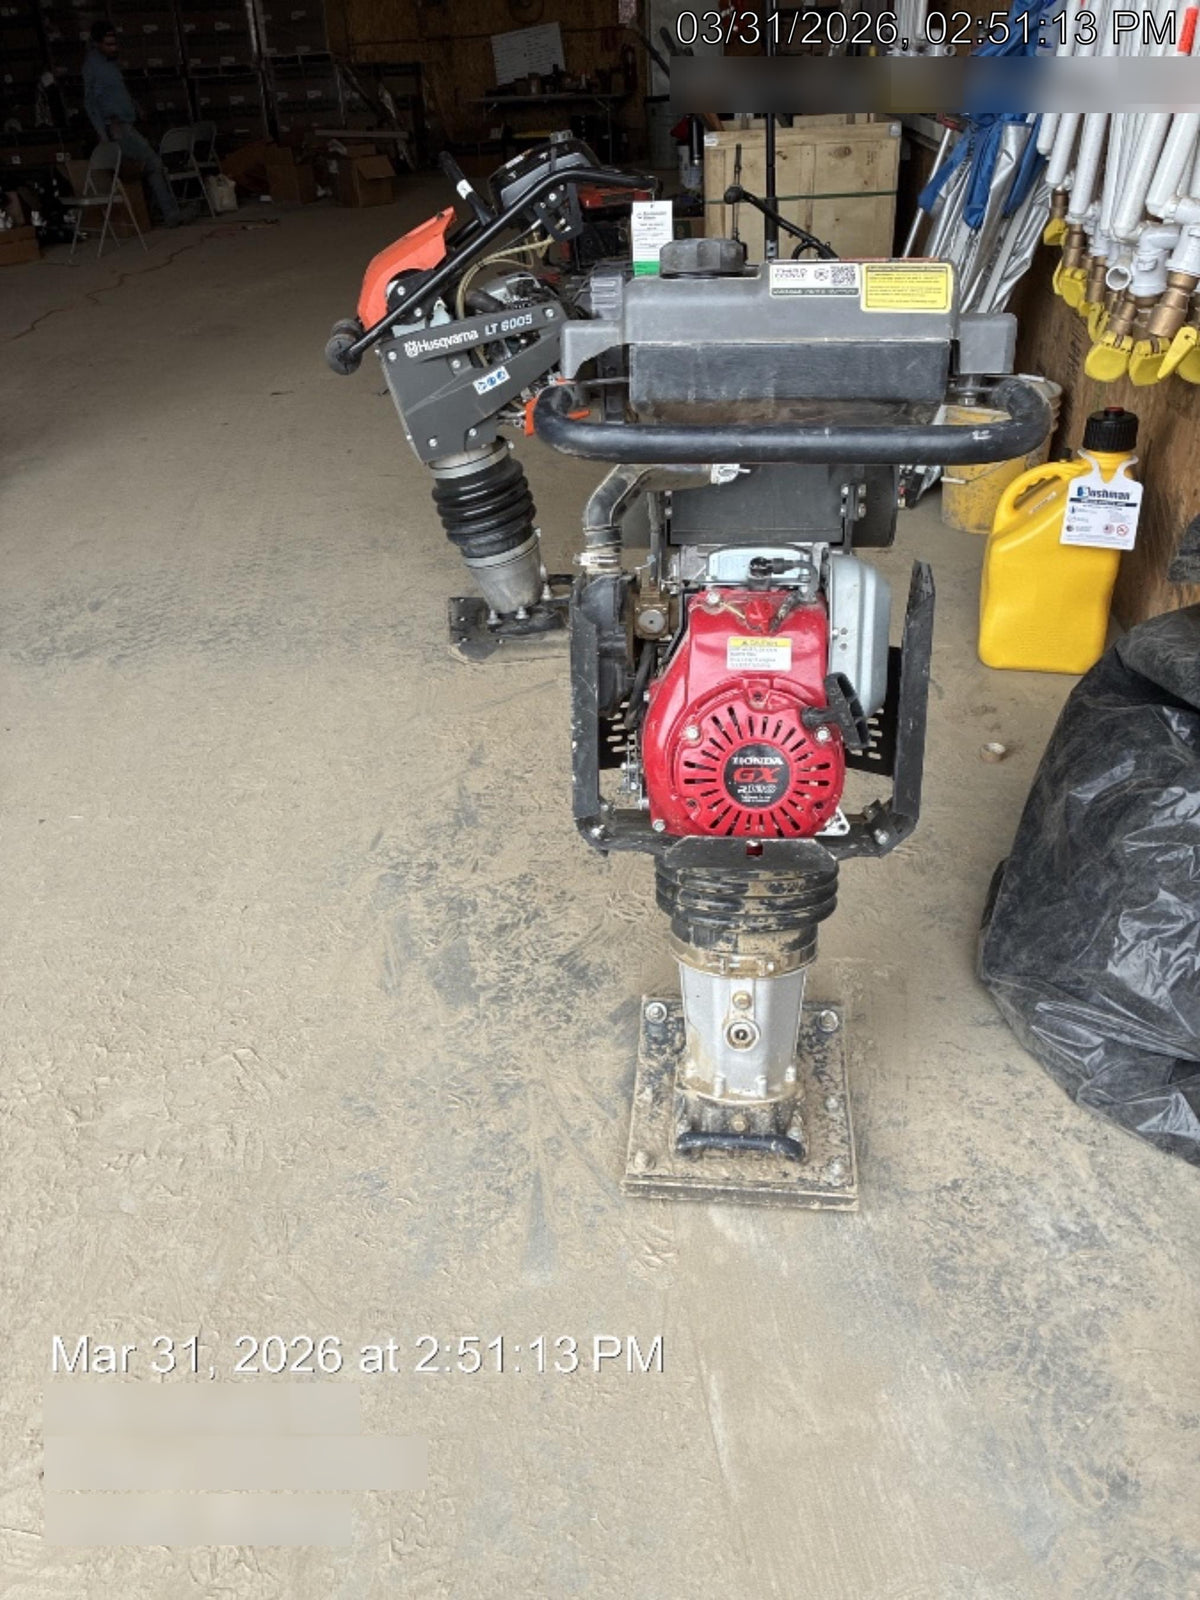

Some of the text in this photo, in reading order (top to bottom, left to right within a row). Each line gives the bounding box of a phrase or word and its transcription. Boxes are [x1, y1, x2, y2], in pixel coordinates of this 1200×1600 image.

[418, 313, 532, 352] Husqvarna LT 6005
[732, 757, 784, 765] HONDA
[733, 768, 780, 783] GX
